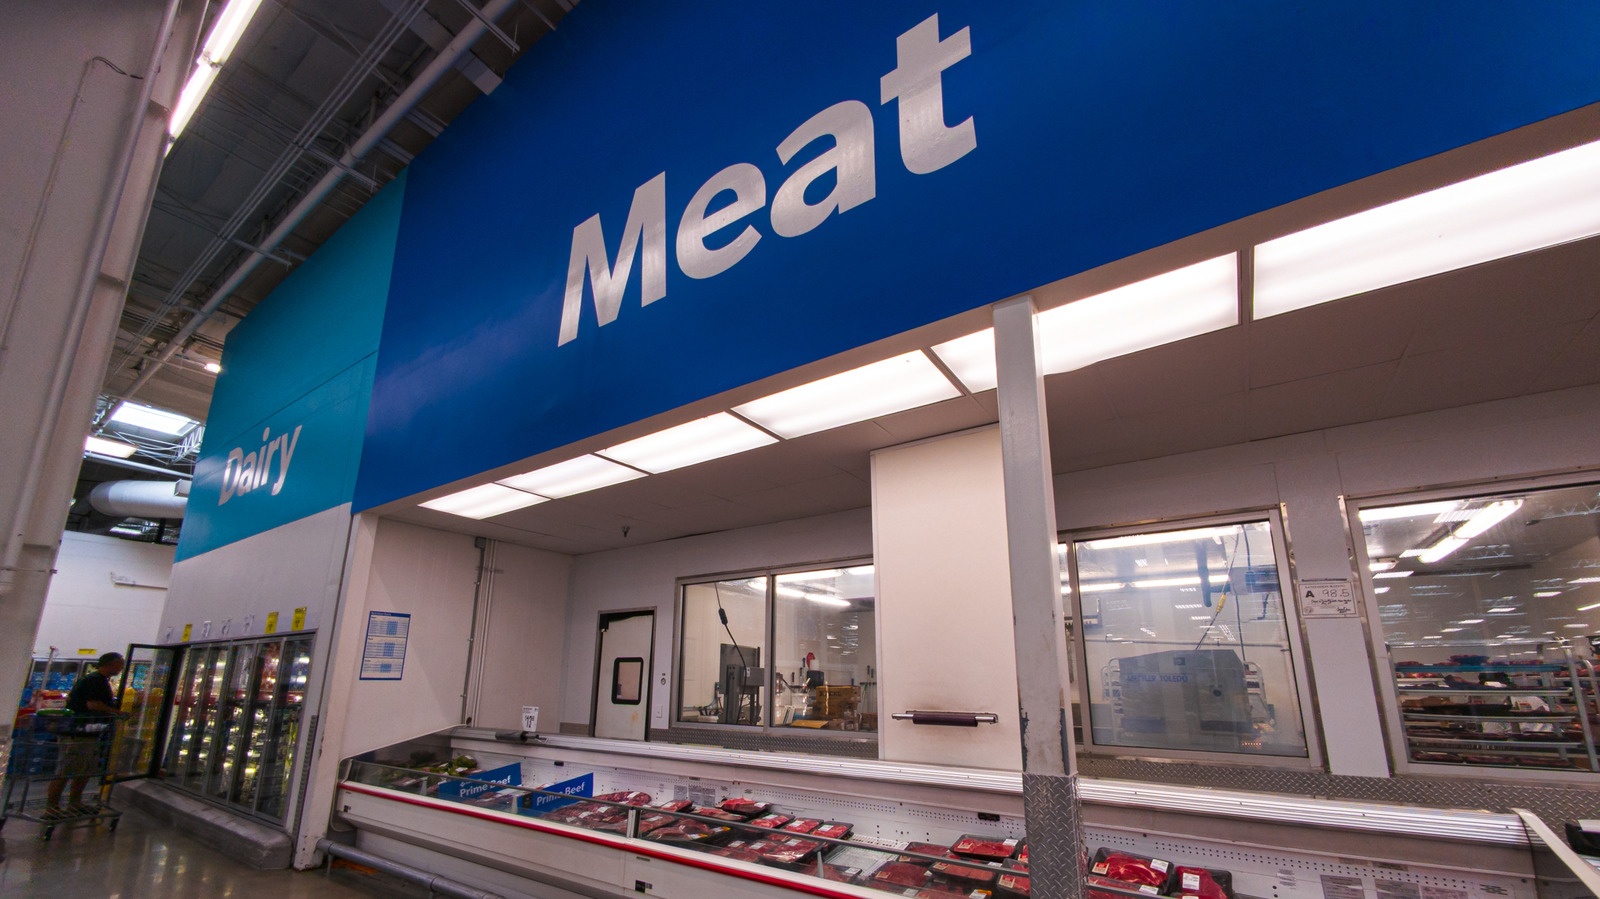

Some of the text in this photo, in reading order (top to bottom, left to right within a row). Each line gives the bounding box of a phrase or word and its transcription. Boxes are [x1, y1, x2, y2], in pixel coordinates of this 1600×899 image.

[558, 12, 977, 348] Meat
[217, 424, 303, 506] Dairy
[1305, 588, 1350, 599] A 98.5
[1159, 674, 1188, 683] TOLEDO
[459, 783, 488, 798] Prime
[565, 781, 586, 796] Beef
